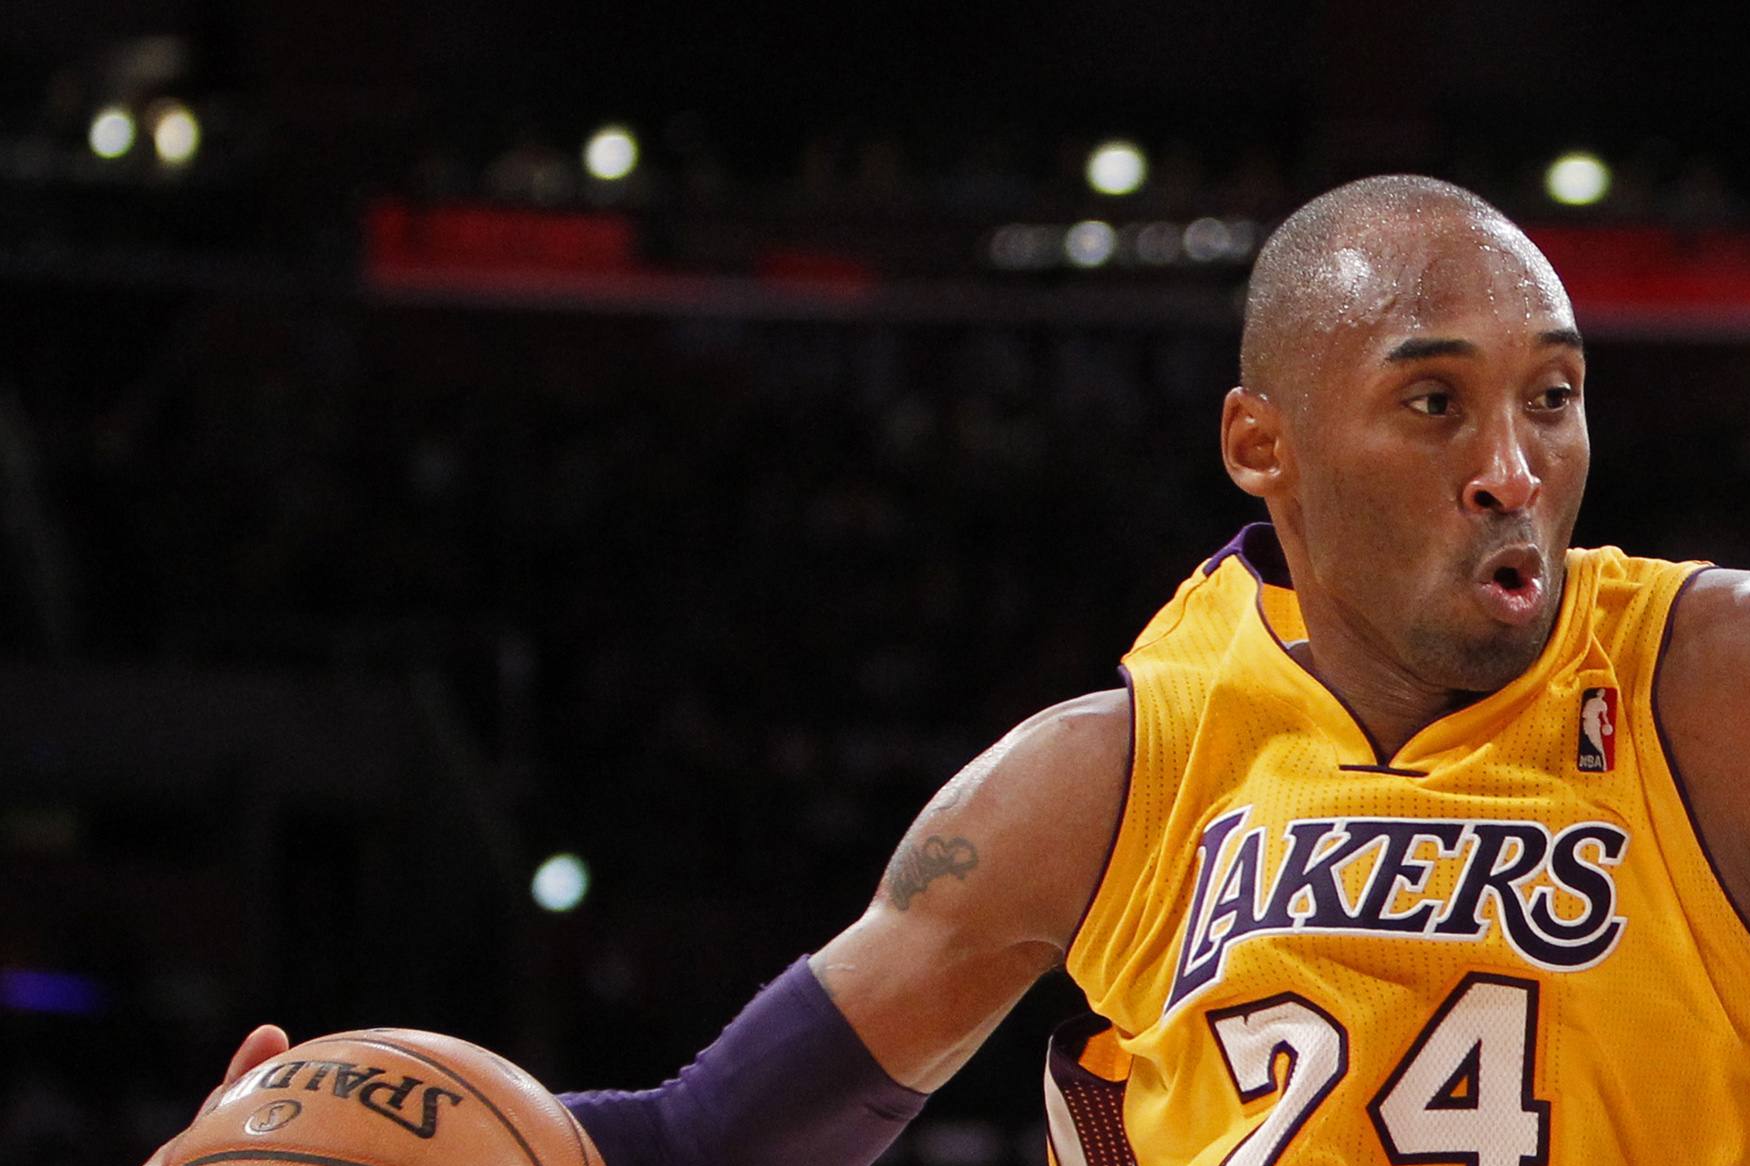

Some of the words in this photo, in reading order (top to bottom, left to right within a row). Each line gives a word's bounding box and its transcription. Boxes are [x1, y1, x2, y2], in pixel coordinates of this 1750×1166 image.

[1579, 754, 1602, 768] NBA
[1163, 805, 1628, 1019] LAKERS
[222, 1060, 463, 1139] SPALD
